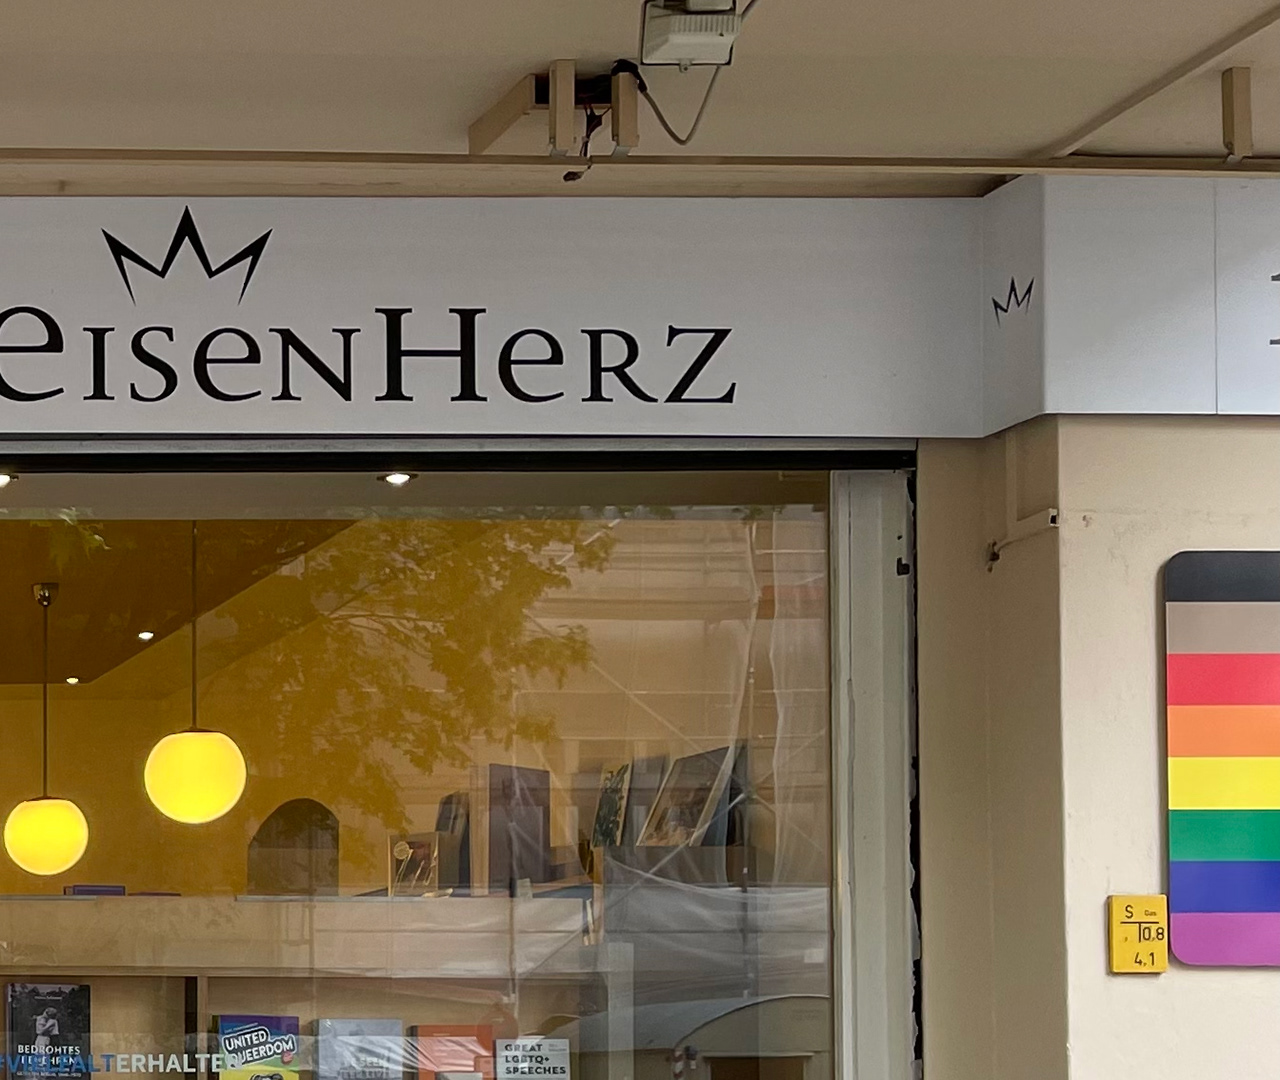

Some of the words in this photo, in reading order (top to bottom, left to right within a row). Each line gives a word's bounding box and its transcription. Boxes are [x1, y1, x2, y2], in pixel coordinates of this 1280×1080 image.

[1124, 904, 1134, 919] S
[225, 1030, 267, 1051] UNITED
[18, 1045, 80, 1055] BEDROHTES
[227, 1036, 294, 1066] QUEERDOM
[505, 1044, 543, 1052] GREAT
[505, 1066, 566, 1075] SPEECHES
